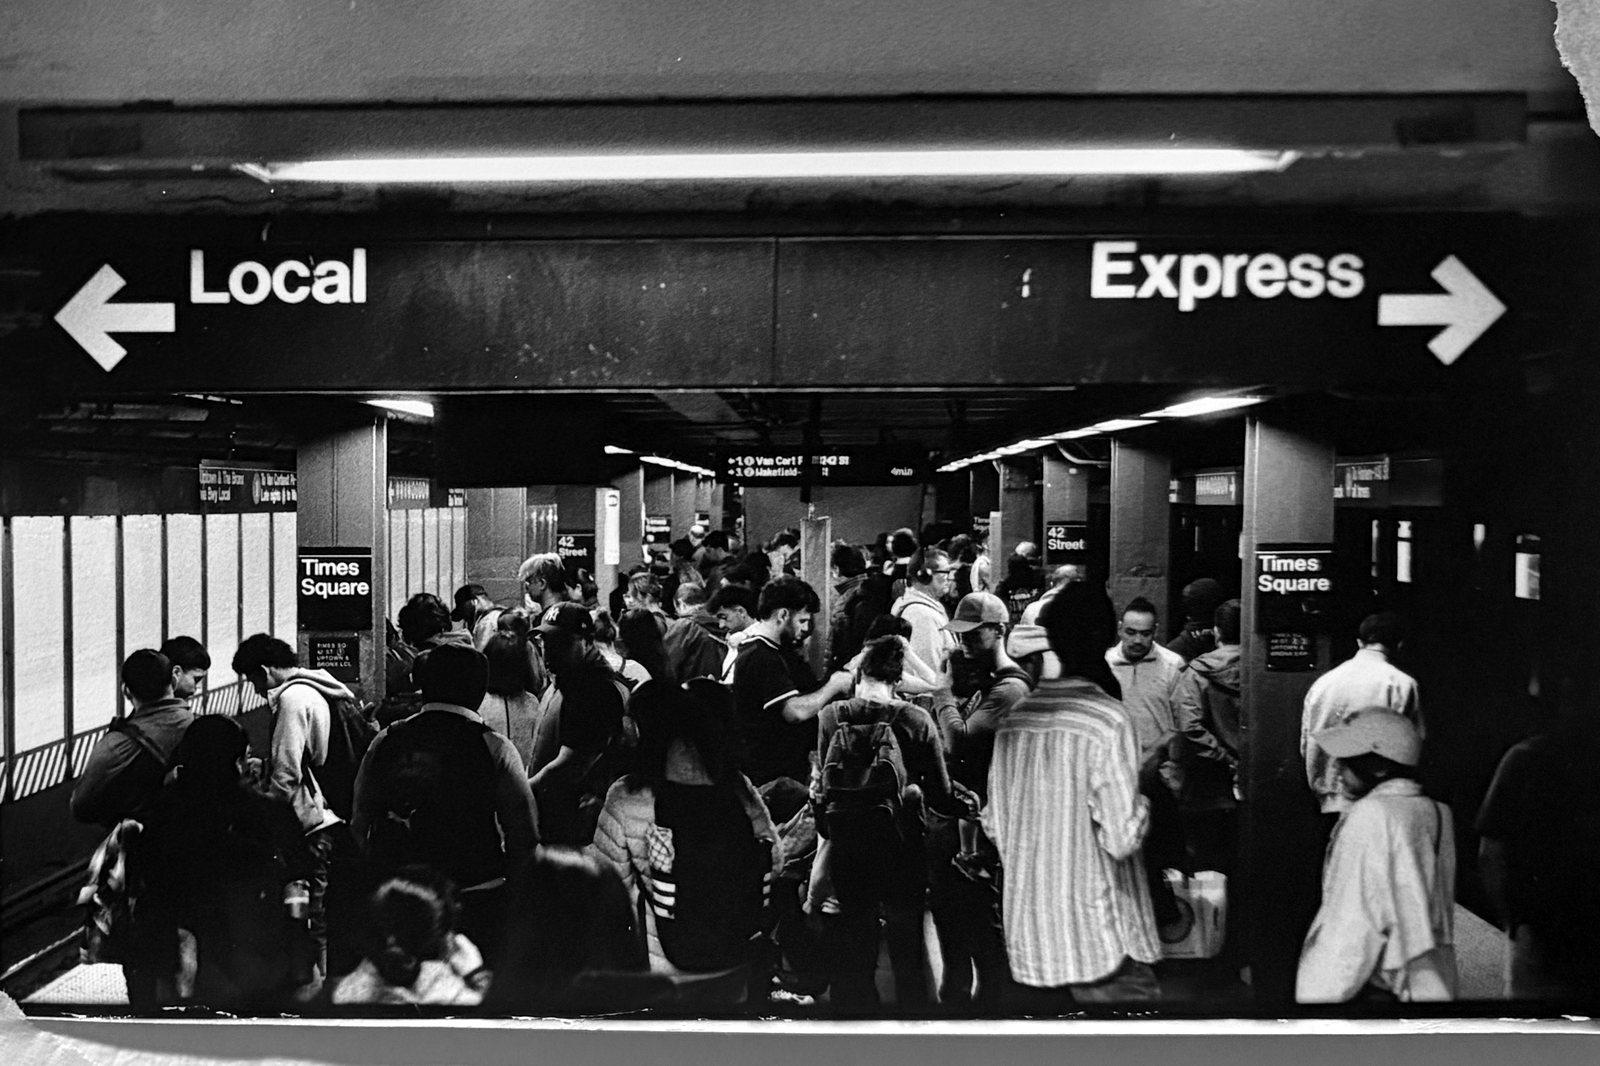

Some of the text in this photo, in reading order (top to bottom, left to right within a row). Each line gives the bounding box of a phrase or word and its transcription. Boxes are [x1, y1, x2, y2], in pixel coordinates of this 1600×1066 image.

[190, 248, 367, 305] Local
[1091, 240, 1366, 312] Express
[756, 456, 774, 466] Van
[775, 456, 796, 466] Cort
[1048, 527, 1065, 538] 42
[558, 536, 575, 547] 42
[1048, 538, 1085, 550] Street
[558, 547, 588, 557] Street
[301, 559, 360, 576] Times
[1258, 555, 1321, 572] Times
[301, 578, 370, 599] Square
[1258, 574, 1331, 595] Square
